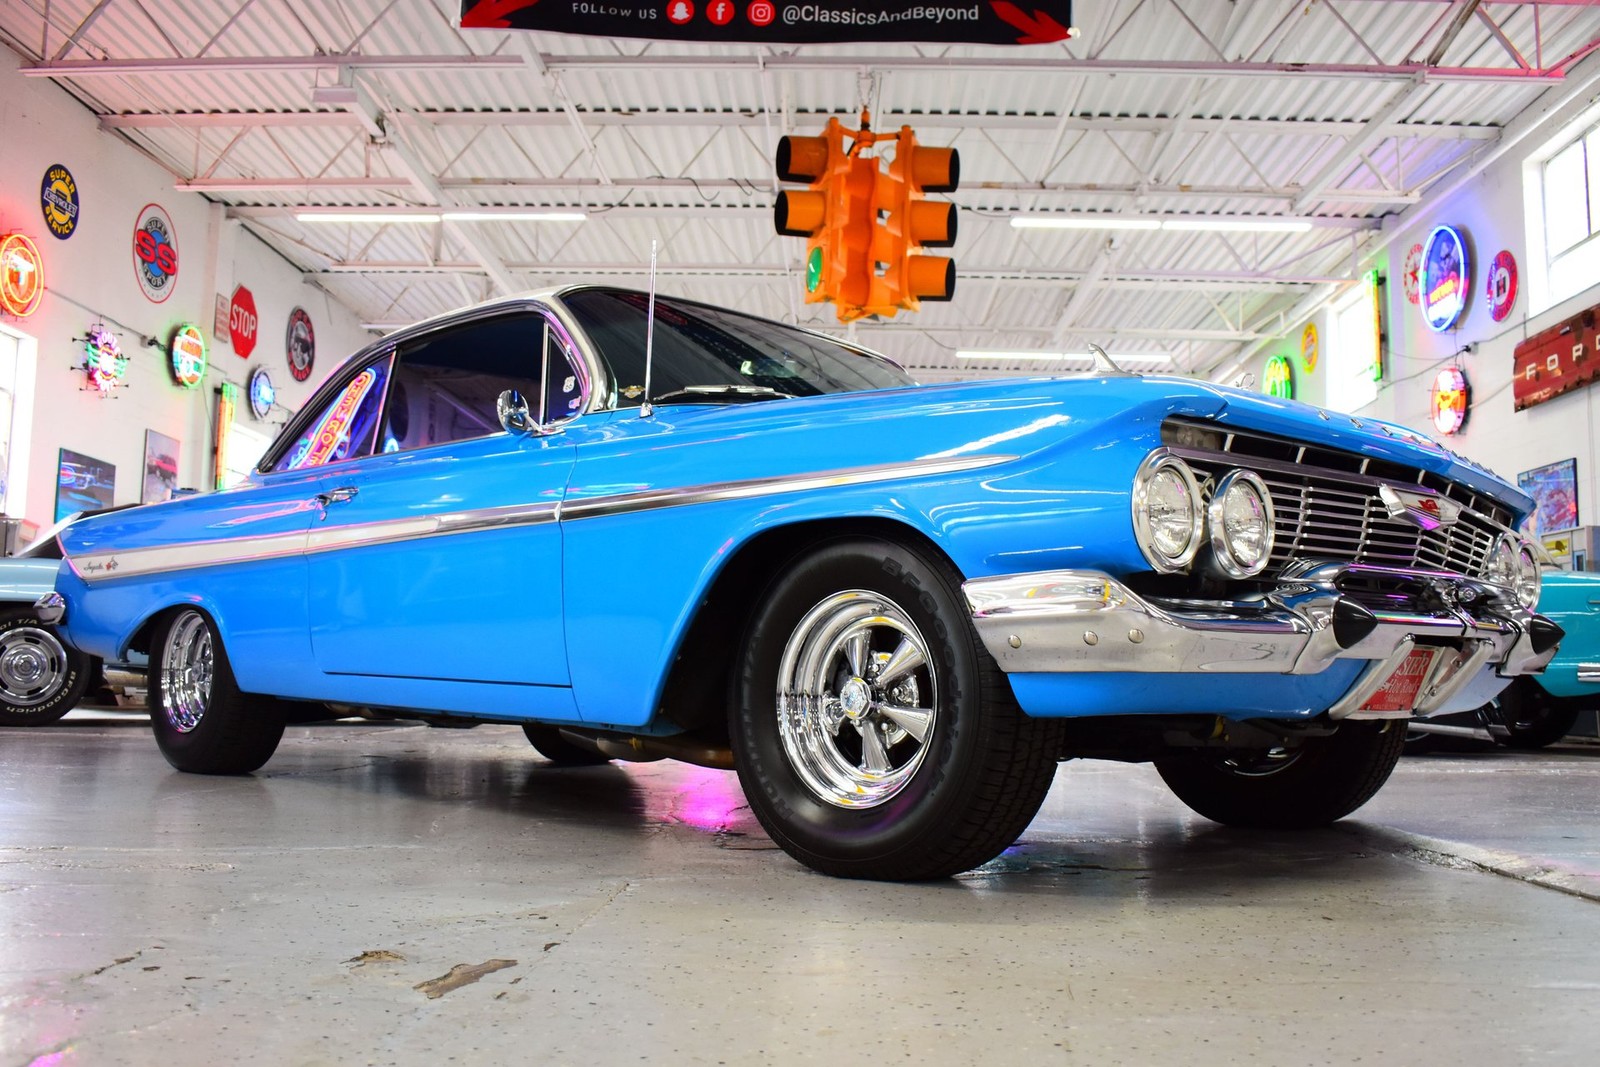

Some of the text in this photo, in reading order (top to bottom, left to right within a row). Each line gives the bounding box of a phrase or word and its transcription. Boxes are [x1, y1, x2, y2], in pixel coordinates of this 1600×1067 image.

[572, 3, 658, 19] FOLLOW US
[782, 5, 979, 25] @ClassicsAndBeyond
[49, 169, 75, 194] SUPER
[46, 189, 78, 216] CHEVROLET
[45, 206, 74, 234] SERVICE
[136, 229, 177, 276] SS
[231, 304, 256, 340] STOP
[1395, 656, 1430, 676] SIER
[6, 670, 77, 713] BFGoodrich
